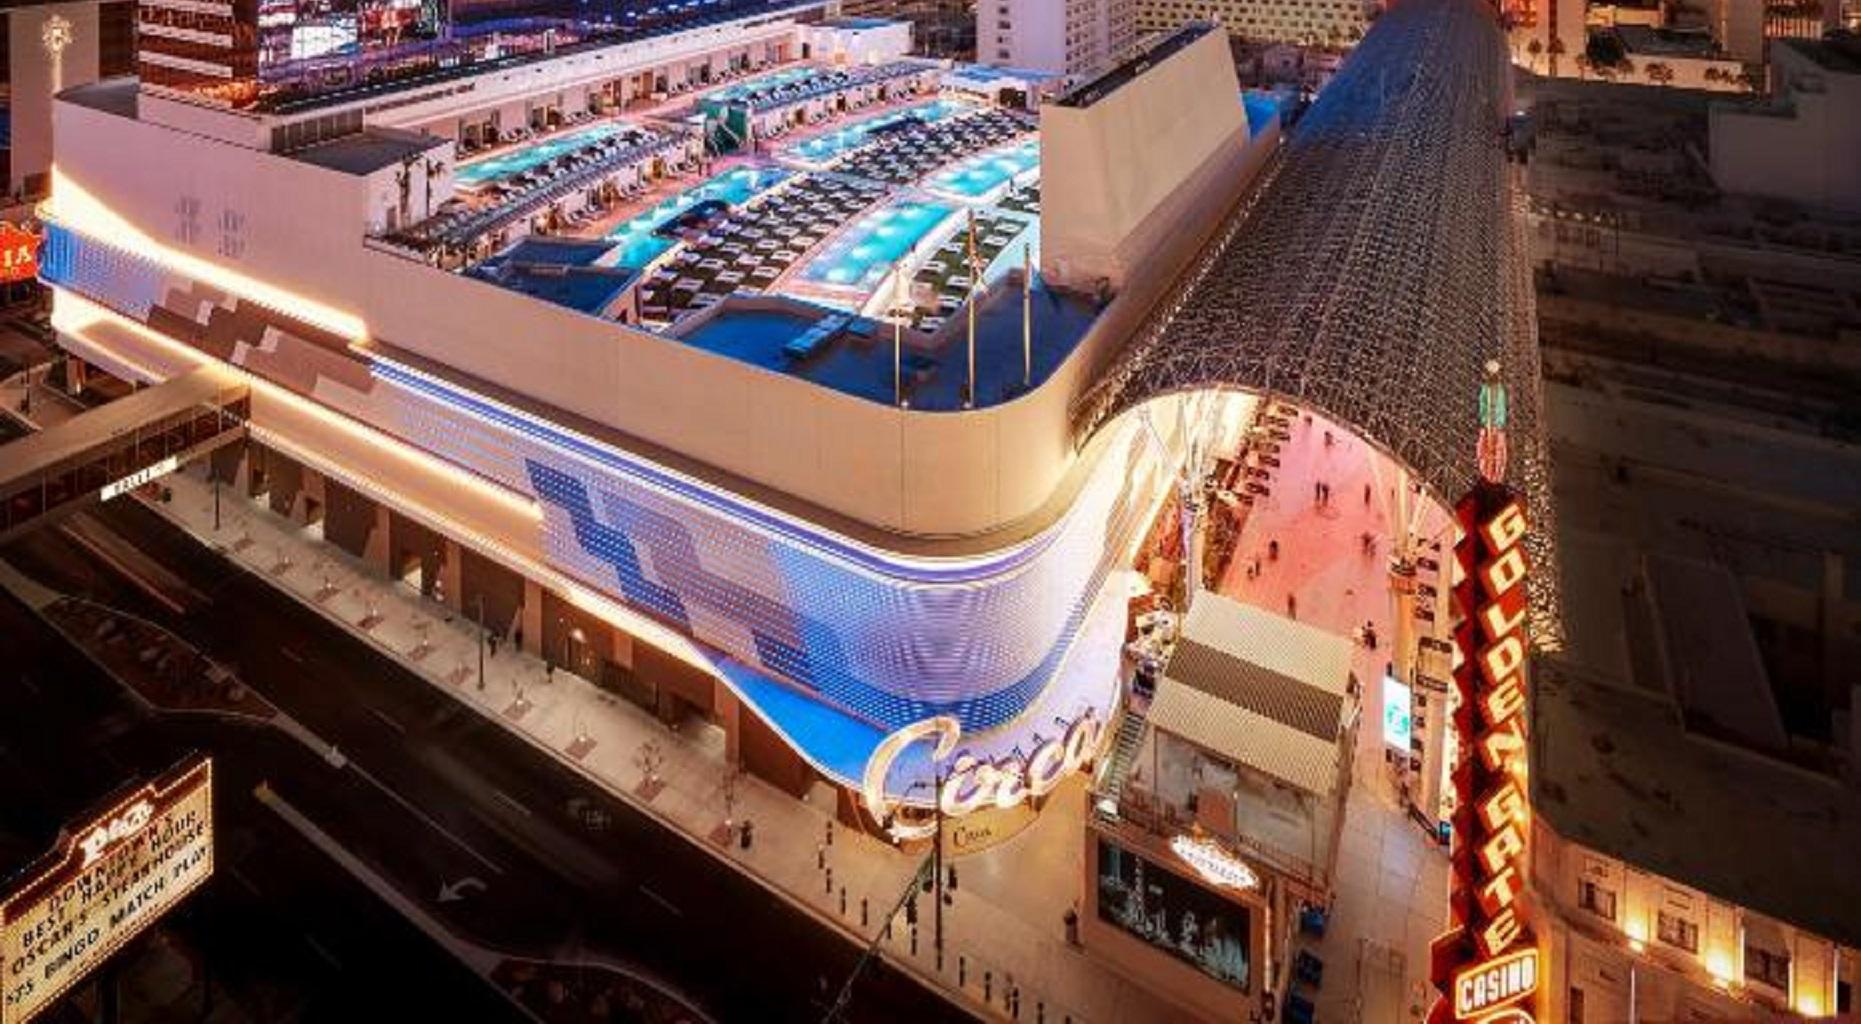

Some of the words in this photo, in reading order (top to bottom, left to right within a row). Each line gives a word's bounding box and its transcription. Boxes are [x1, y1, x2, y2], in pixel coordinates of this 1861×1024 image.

[1484, 503, 1528, 774] GOLDEN
[864, 714, 1101, 844] Circa
[22, 905, 66, 949] BEST
[44, 928, 100, 980] BINGO
[110, 876, 164, 928] MATCH
[173, 846, 206, 880] PLAY
[1483, 782, 1525, 956] GATE
[1461, 956, 1534, 1012] CASINO
